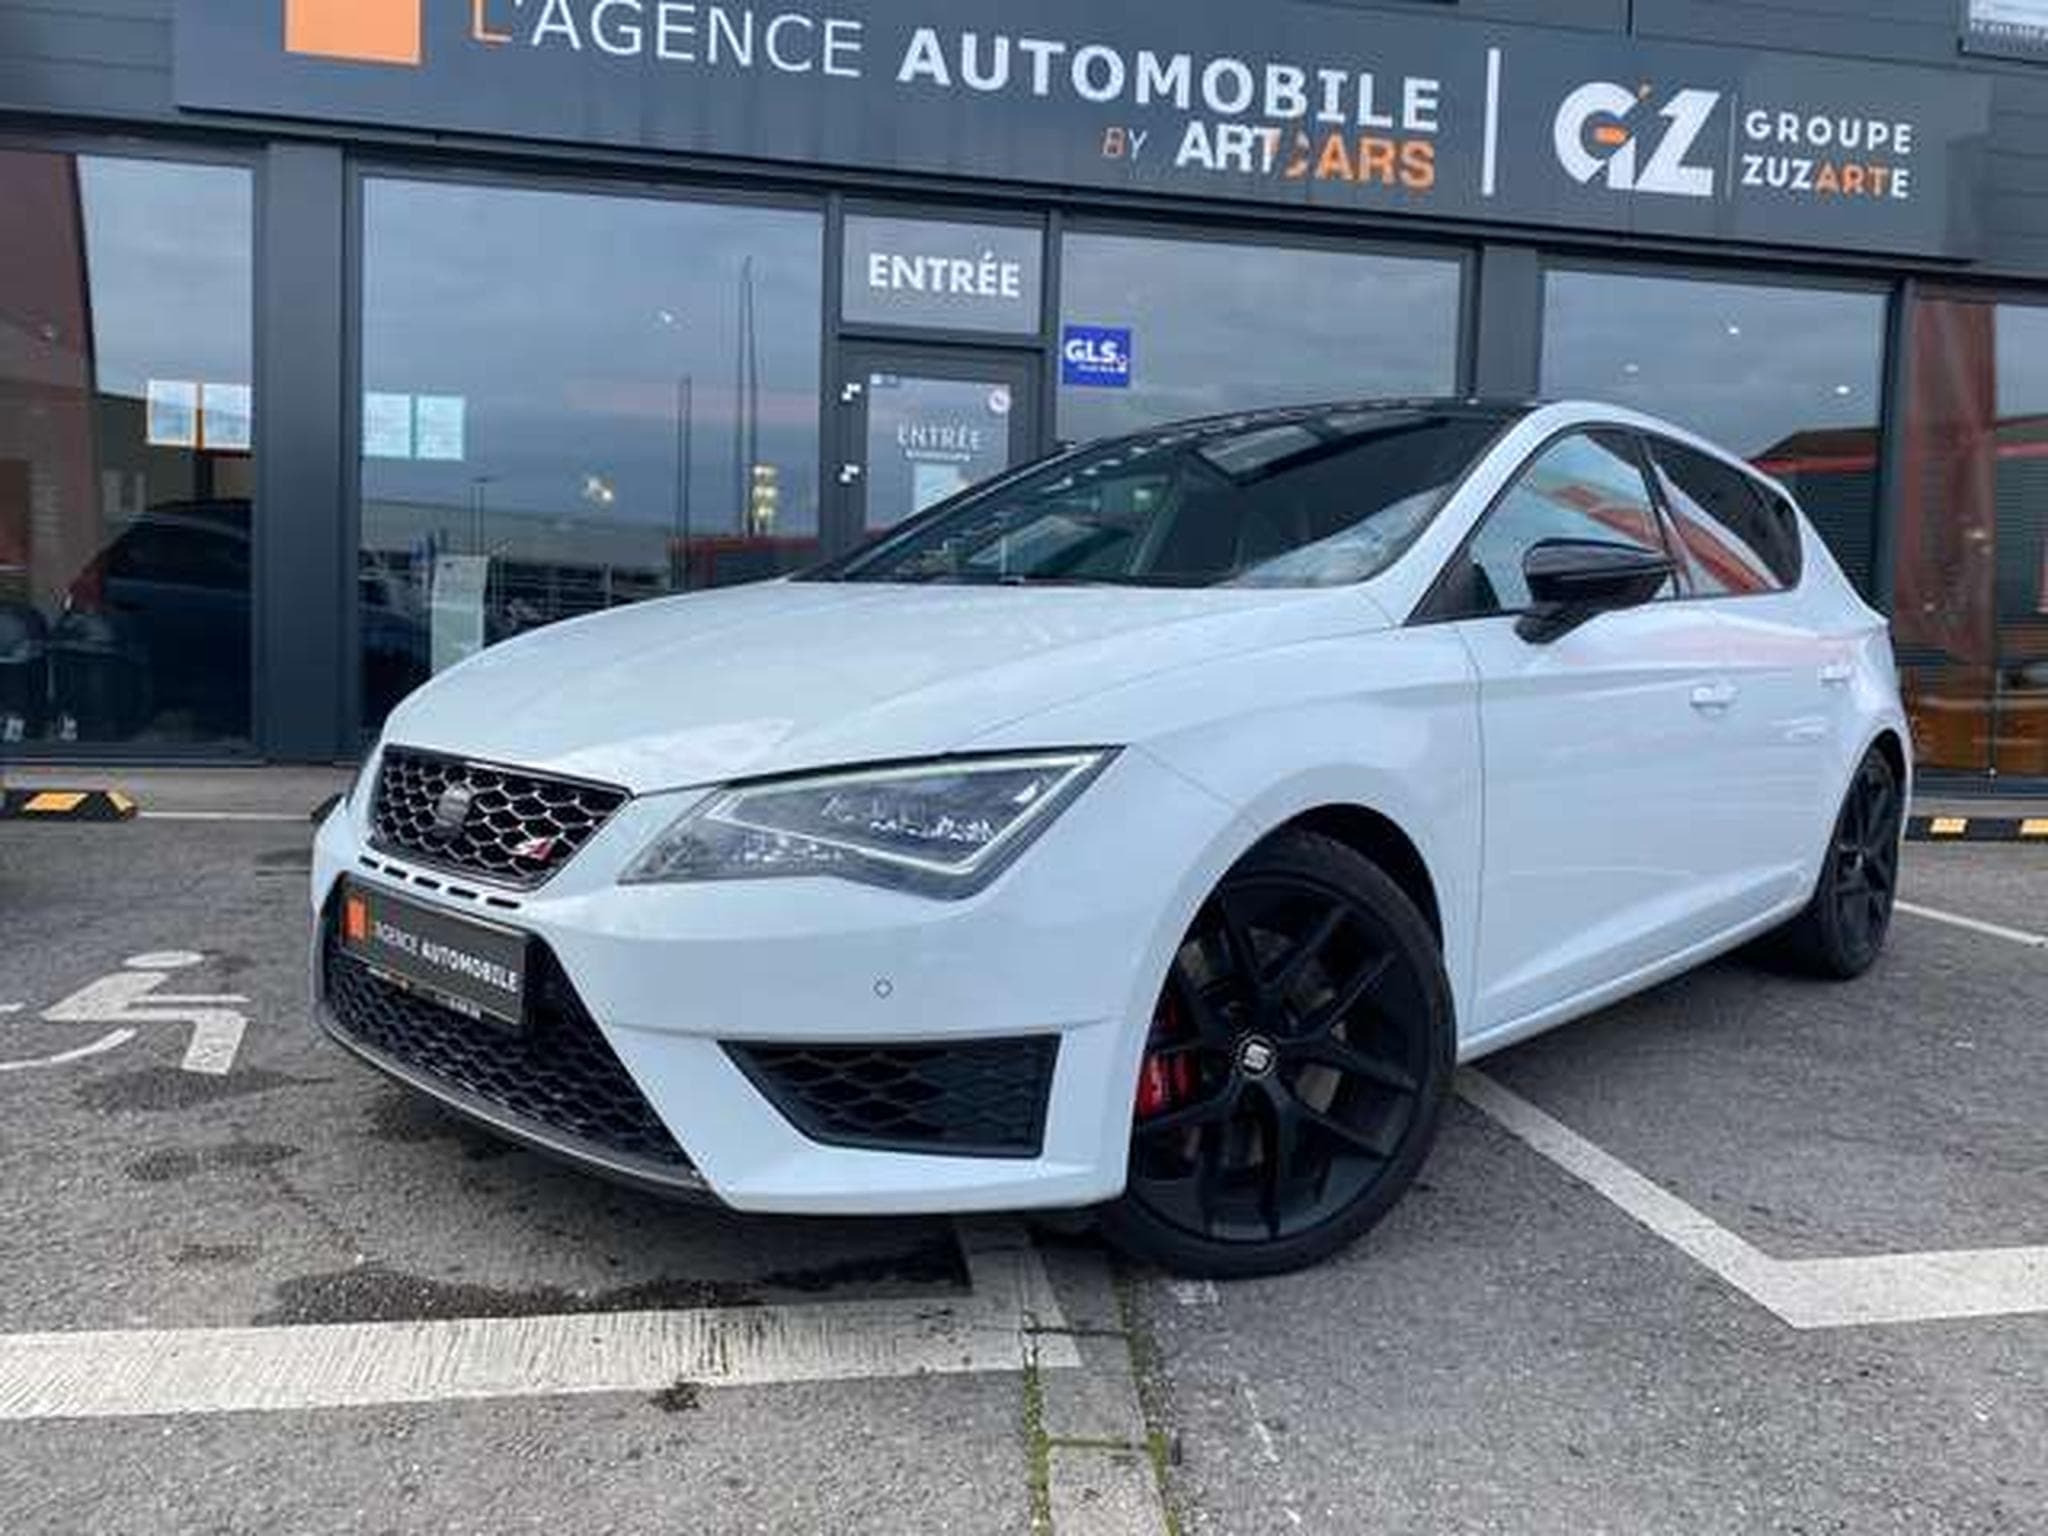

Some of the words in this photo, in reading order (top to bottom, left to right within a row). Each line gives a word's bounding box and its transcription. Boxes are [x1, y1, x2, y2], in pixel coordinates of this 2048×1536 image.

[897, 28, 1440, 131] AUTOMOBILE
[1102, 126, 1149, 161] BY
[1745, 109, 1914, 155] GROUPE
[1741, 155, 1911, 199] ZUZARTE
[868, 251, 1020, 298] ENTRÉE
[1065, 338, 1119, 363] GLS
